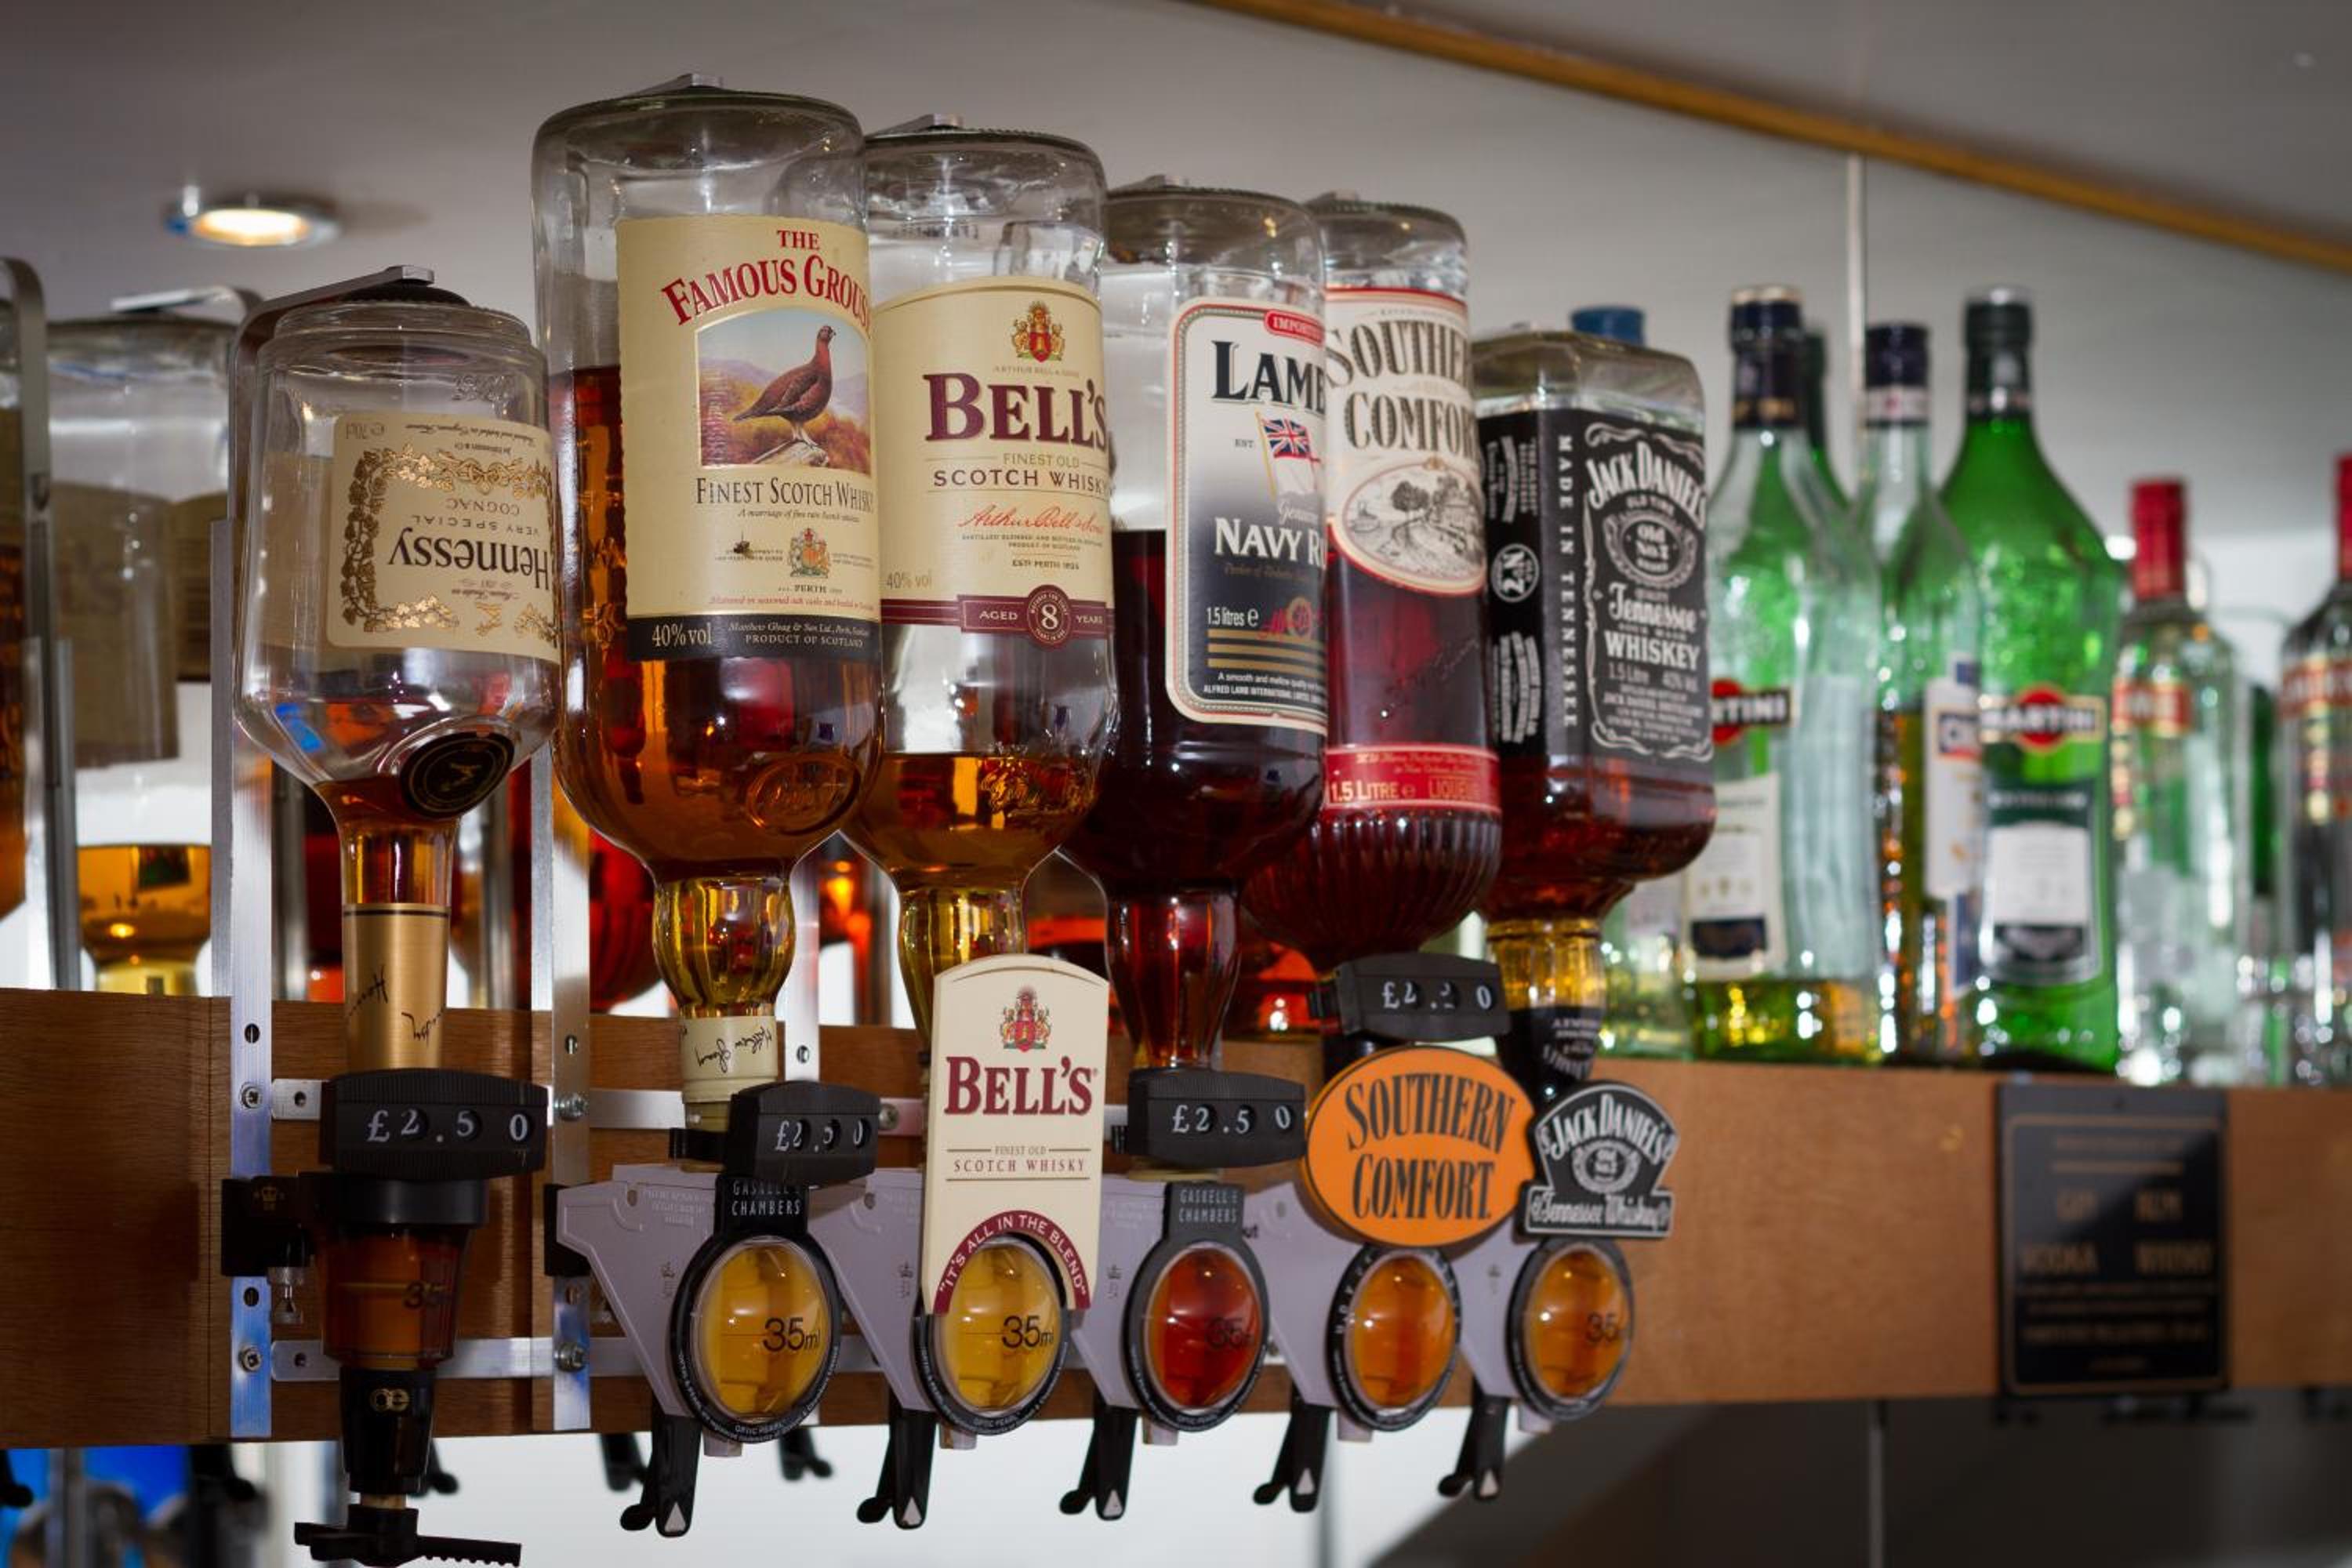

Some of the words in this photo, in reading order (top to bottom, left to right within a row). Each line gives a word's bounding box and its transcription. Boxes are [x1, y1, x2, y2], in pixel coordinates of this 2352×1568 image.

[777, 230, 820, 250] THE
[662, 259, 797, 325] FAMOUS
[804, 254, 871, 339] GROUS
[923, 372, 1106, 453] BELL'S
[1343, 391, 1480, 463] COMFOR
[1003, 453, 1052, 466] FINEST
[1057, 455, 1080, 468] OLD
[1558, 435, 1573, 510] MADE
[934, 470, 1038, 488] SCOTCH
[1049, 470, 1107, 495] WHISK
[1585, 452, 1637, 510] JACK
[445, 498, 520, 516] COGNAC
[695, 477, 764, 504] FINEST
[771, 477, 832, 506] SCOTCH
[836, 480, 873, 514] WHISK
[412, 514, 499, 529] SPECIAL
[506, 525, 539, 537] VERY
[1214, 517, 1302, 562] NAVY
[1559, 525, 1574, 555] IN
[387, 527, 550, 590] Hennessy
[886, 572, 913, 590] 40%
[915, 571, 931, 589] vol
[979, 611, 1018, 621] AGED
[1041, 604, 1058, 630] 8
[1076, 615, 1103, 624] YEARS
[1206, 606, 1221, 626] 1.5
[1221, 606, 1245, 627] litres
[652, 625, 686, 647] 40%
[688, 622, 712, 646] vol
[746, 634, 800, 644] PRODUCT
[804, 635, 818, 644] OF
[1560, 573, 1577, 728] TENNESSEE
[1603, 630, 1700, 670] WHISKEY
[1331, 780, 1354, 802] 1.5
[1356, 779, 1399, 800] LITRE
[944, 1055, 1092, 1116] BELL'S
[1345, 1073, 1515, 1154] SOUTHERN
[1551, 1105, 1598, 1160] JACK
[1599, 1094, 1666, 1165] DANIEL'S
[995, 1145, 1025, 1156] FINEST
[1029, 1145, 1047, 1156] OLD
[954, 1160, 1016, 1173] SCOTCH
[1026, 1158, 1084, 1172] WHISKY
[1180, 1189, 1229, 1204] GASKELL
[1352, 1153, 1494, 1220] COMFORT
[732, 1200, 800, 1216] CHAMBERS
[1178, 1208, 1239, 1223] CHAMBERS
[967, 1225, 996, 1253] ALL
[998, 1215, 1014, 1231] IN
[1018, 1214, 1045, 1233] THE
